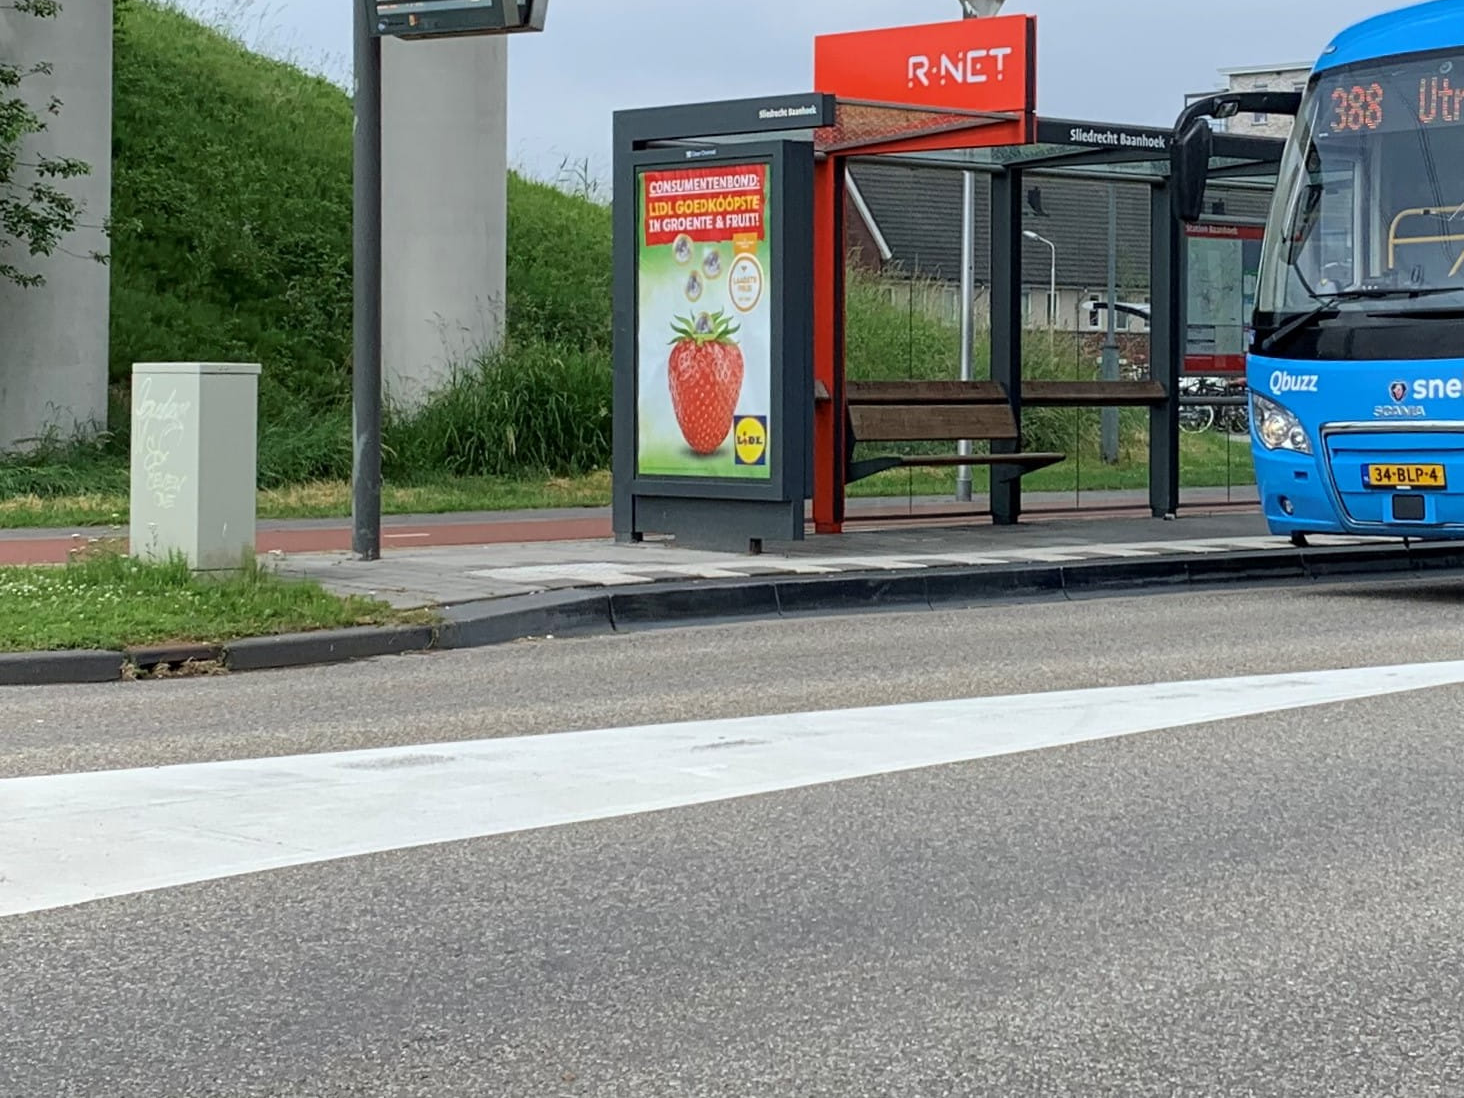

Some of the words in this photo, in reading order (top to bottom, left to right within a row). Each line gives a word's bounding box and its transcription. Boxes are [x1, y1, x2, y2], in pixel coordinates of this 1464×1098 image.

[758, 108, 788, 120] Sliedrecht
[788, 105, 817, 116] Baanhoek
[1330, 82, 1385, 133] 388
[1070, 128, 1118, 144] Sliedrecht
[1120, 133, 1166, 148] Baanhoek
[649, 173, 760, 195] CONSUMENTENBOND:
[649, 201, 674, 216] LIDL
[649, 218, 661, 233] IN
[662, 215, 713, 231] GROENTE
[715, 215, 724, 228] &
[726, 213, 760, 228] FRUIT!
[1269, 370, 1319, 395] Qbuzz
[1373, 405, 1426, 417] SCANIA
[1374, 467, 1439, 484] 34-BLP-4
